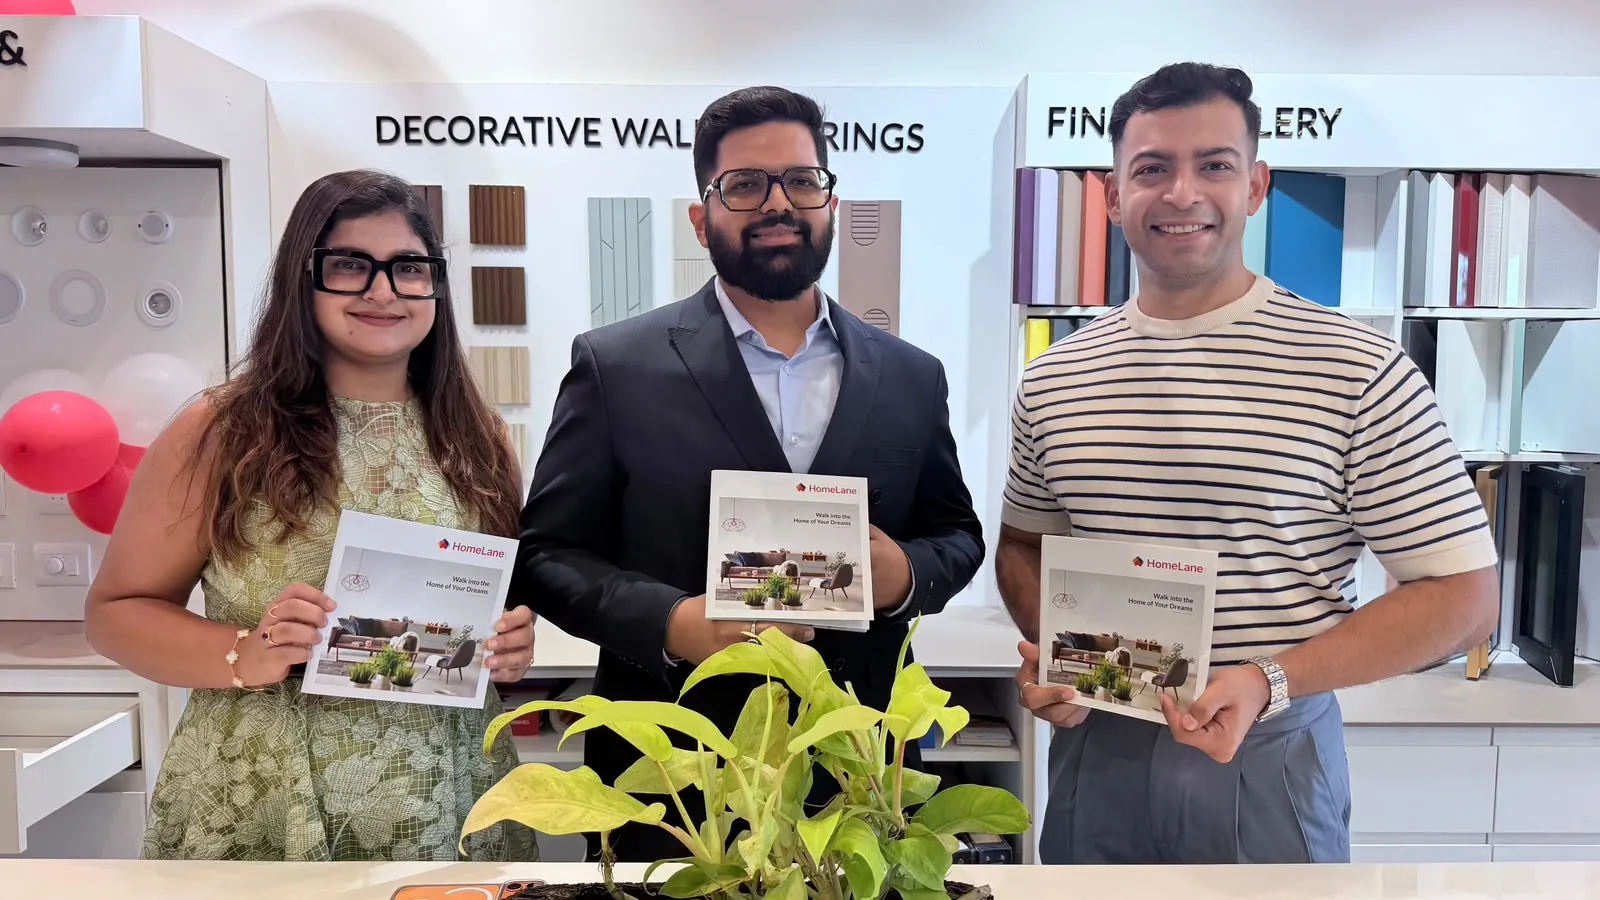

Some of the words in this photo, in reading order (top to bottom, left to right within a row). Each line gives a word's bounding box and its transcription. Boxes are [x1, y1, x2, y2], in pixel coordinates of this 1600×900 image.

[1048, 106, 1106, 138] FIN
[1257, 106, 1343, 139] LERY
[375, 115, 602, 148] DECORATIVE
[611, 117, 700, 148] WAL
[822, 121, 925, 154] RINGS
[808, 484, 857, 495] HomeLane
[452, 541, 505, 558] HomeLane
[1146, 558, 1204, 573] HomeLane
[426, 580, 444, 590] Home
[452, 584, 466, 592] Your
[466, 586, 488, 595] Dreams
[452, 576, 467, 584] Walk
[468, 578, 480, 586] into
[480, 580, 491, 588] the
[1128, 597, 1146, 606] Home
[1154, 601, 1169, 609] Your
[1169, 603, 1193, 612] Dreams
[1153, 592, 1169, 600] Walk
[1169, 595, 1183, 603] into
[1183, 596, 1194, 604] the
